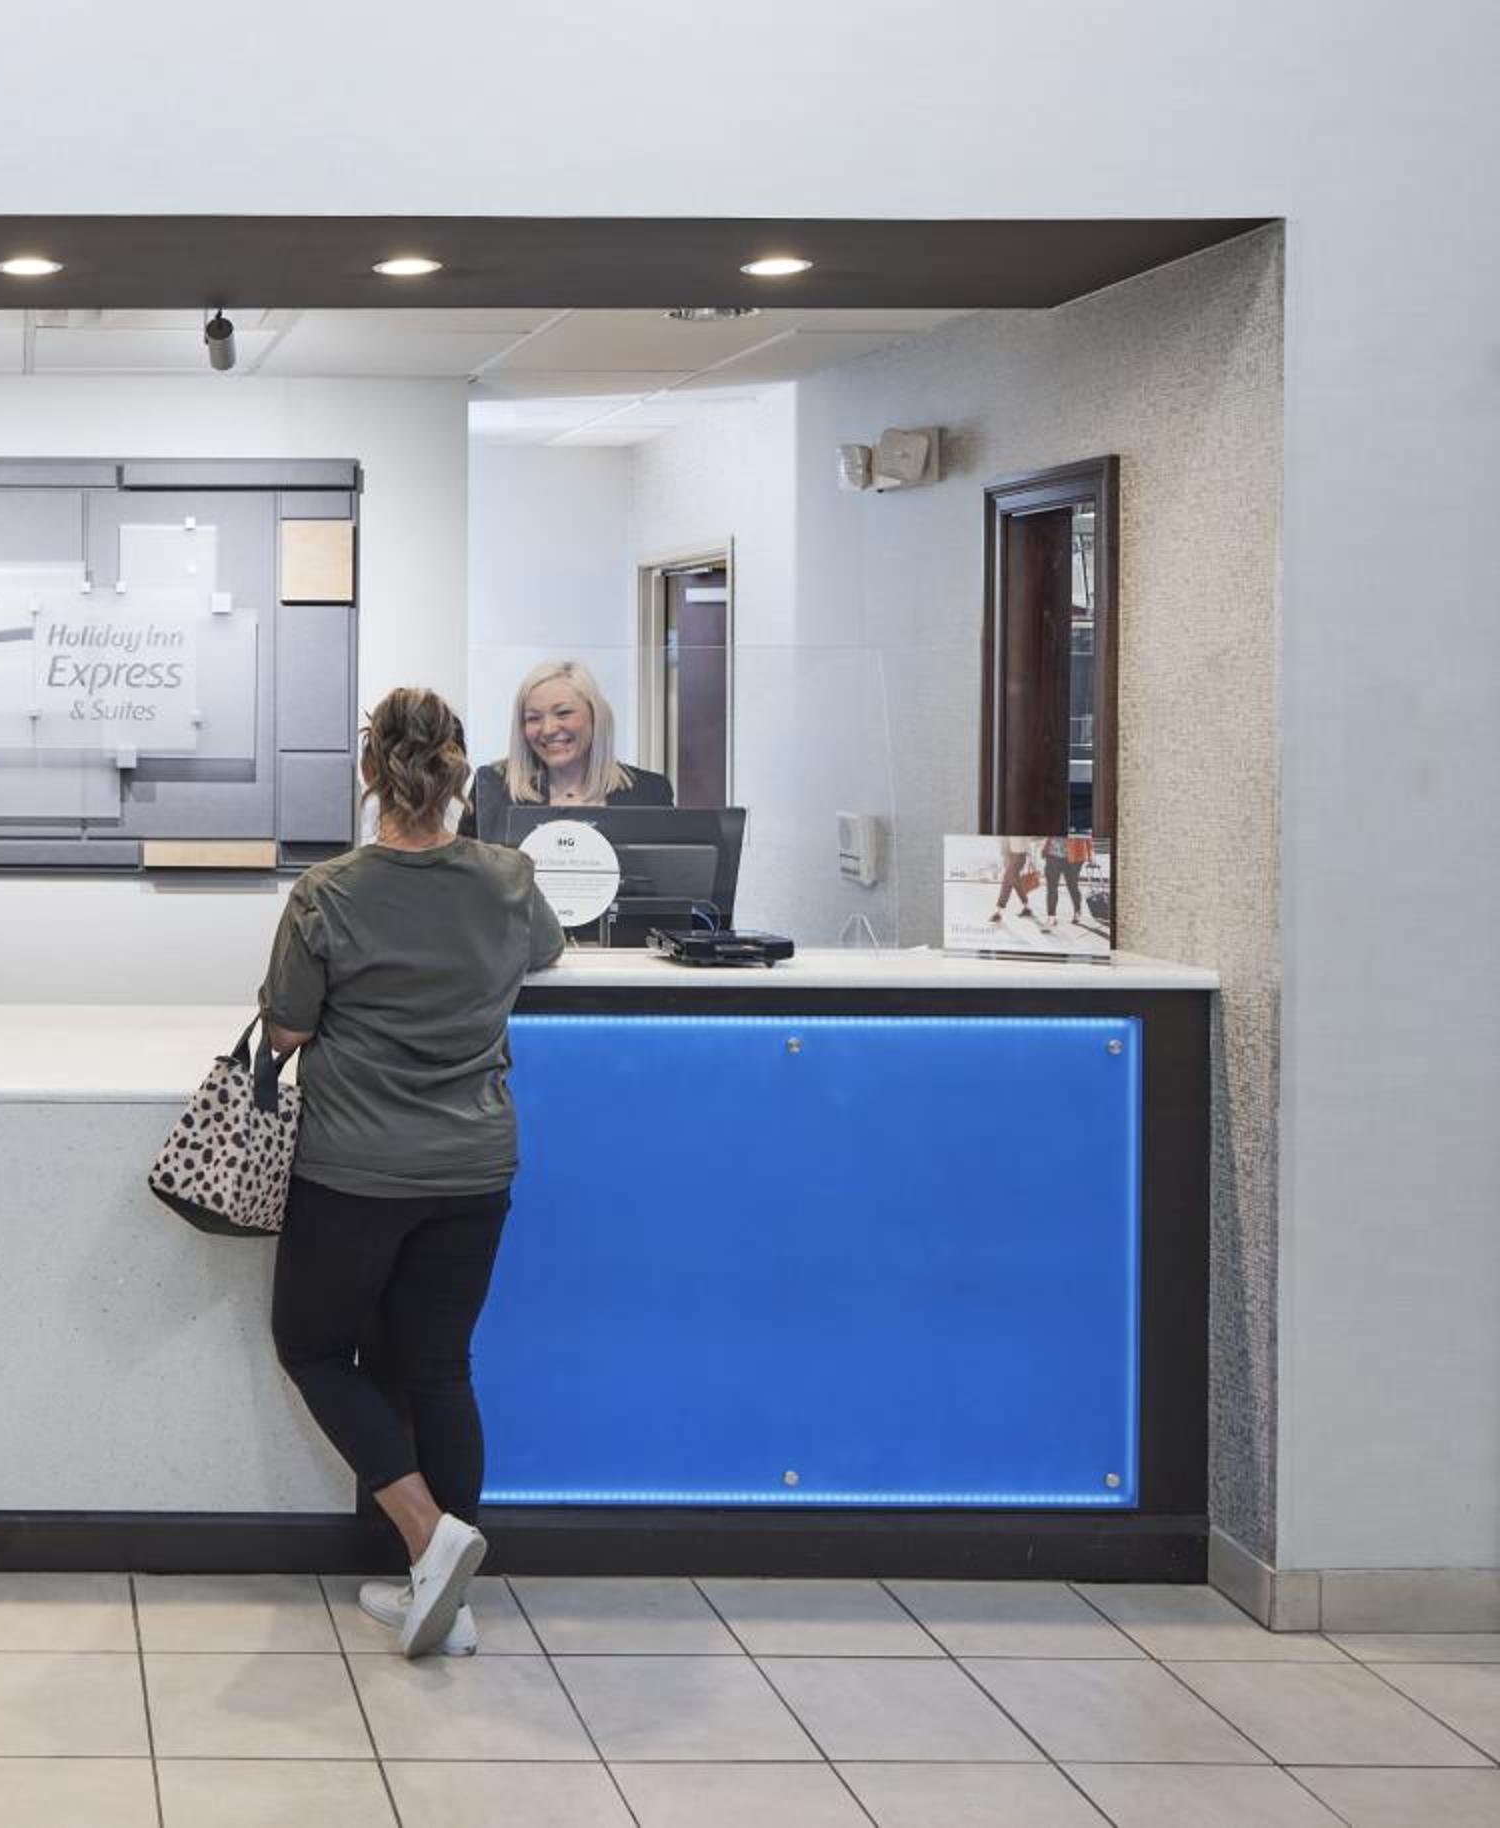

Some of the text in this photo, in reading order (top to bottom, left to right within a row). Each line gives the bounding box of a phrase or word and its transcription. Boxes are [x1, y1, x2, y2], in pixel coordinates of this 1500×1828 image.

[47, 623, 183, 652] Holiday Inn
[47, 656, 183, 695] Express
[70, 699, 156, 720] & Suites
